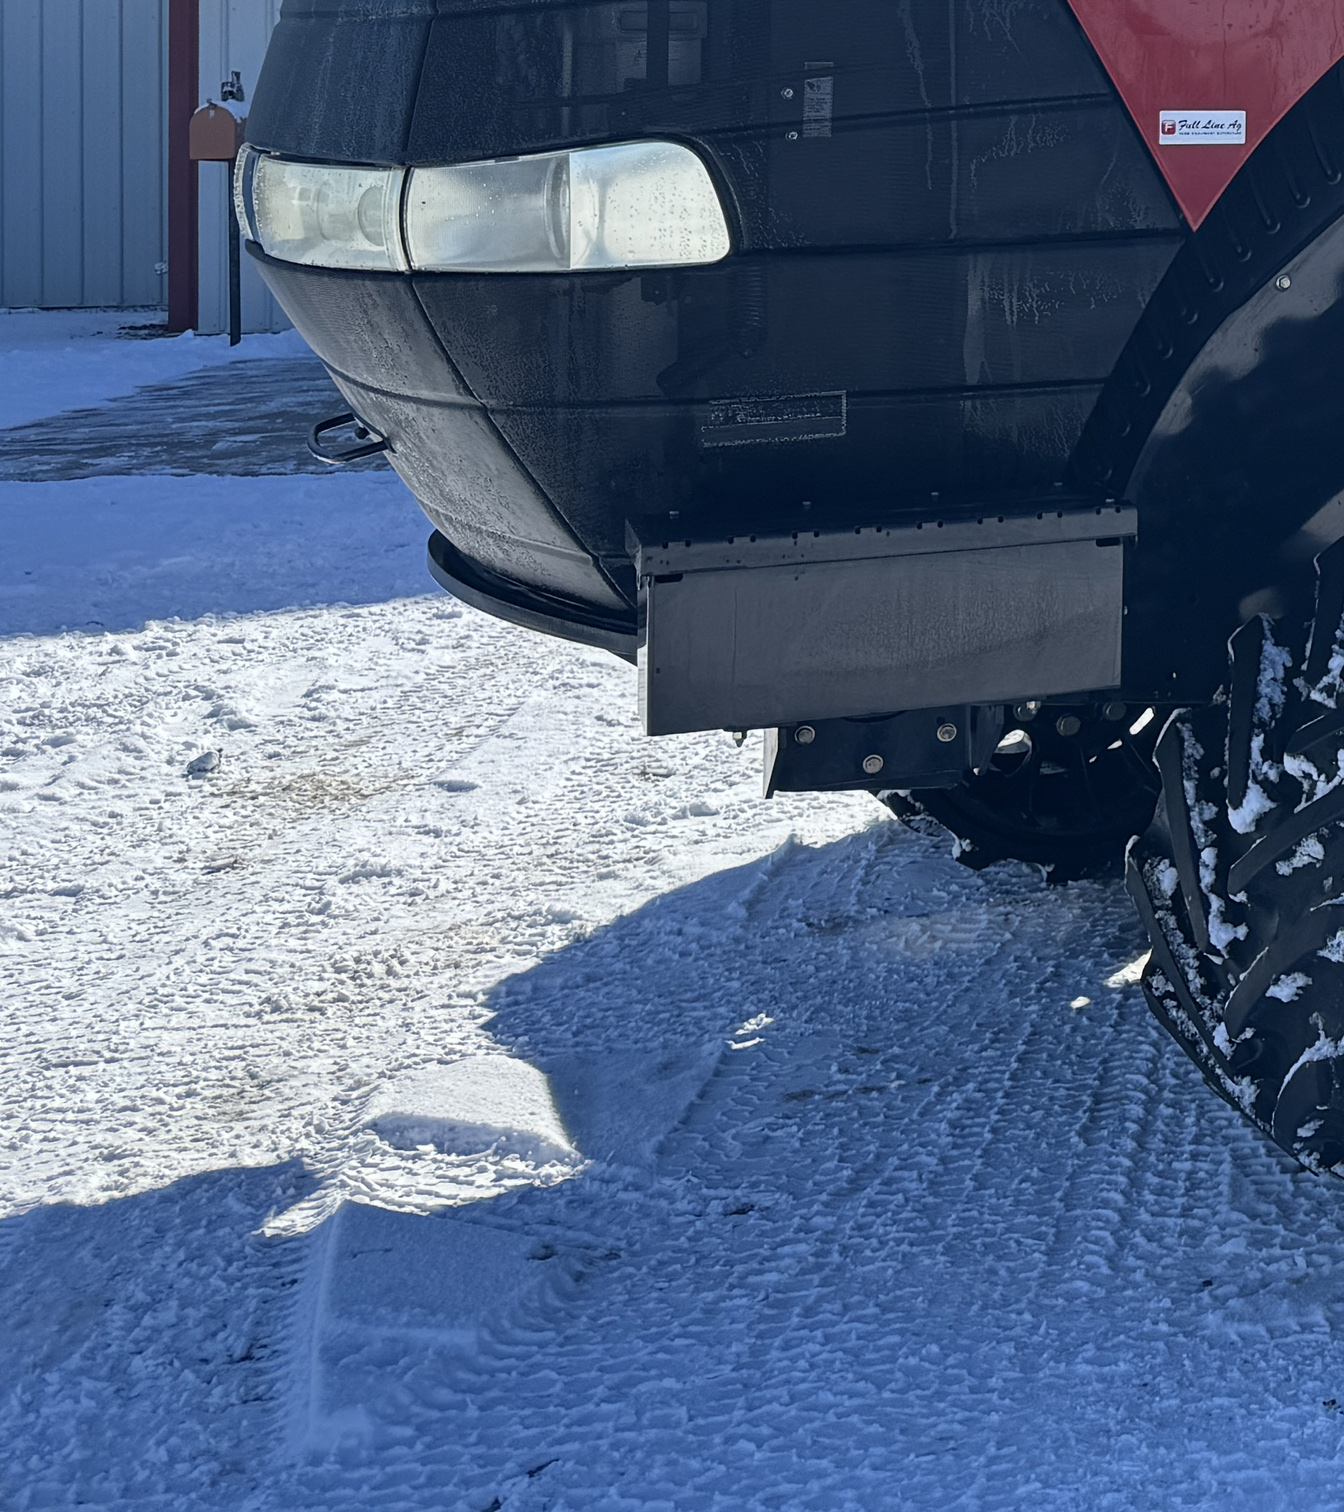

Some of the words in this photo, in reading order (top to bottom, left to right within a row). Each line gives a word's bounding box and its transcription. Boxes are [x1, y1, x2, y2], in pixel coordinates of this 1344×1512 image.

[1178, 119, 1201, 131] Full
[1201, 119, 1225, 130] Line
[1226, 119, 1242, 132] Ag
